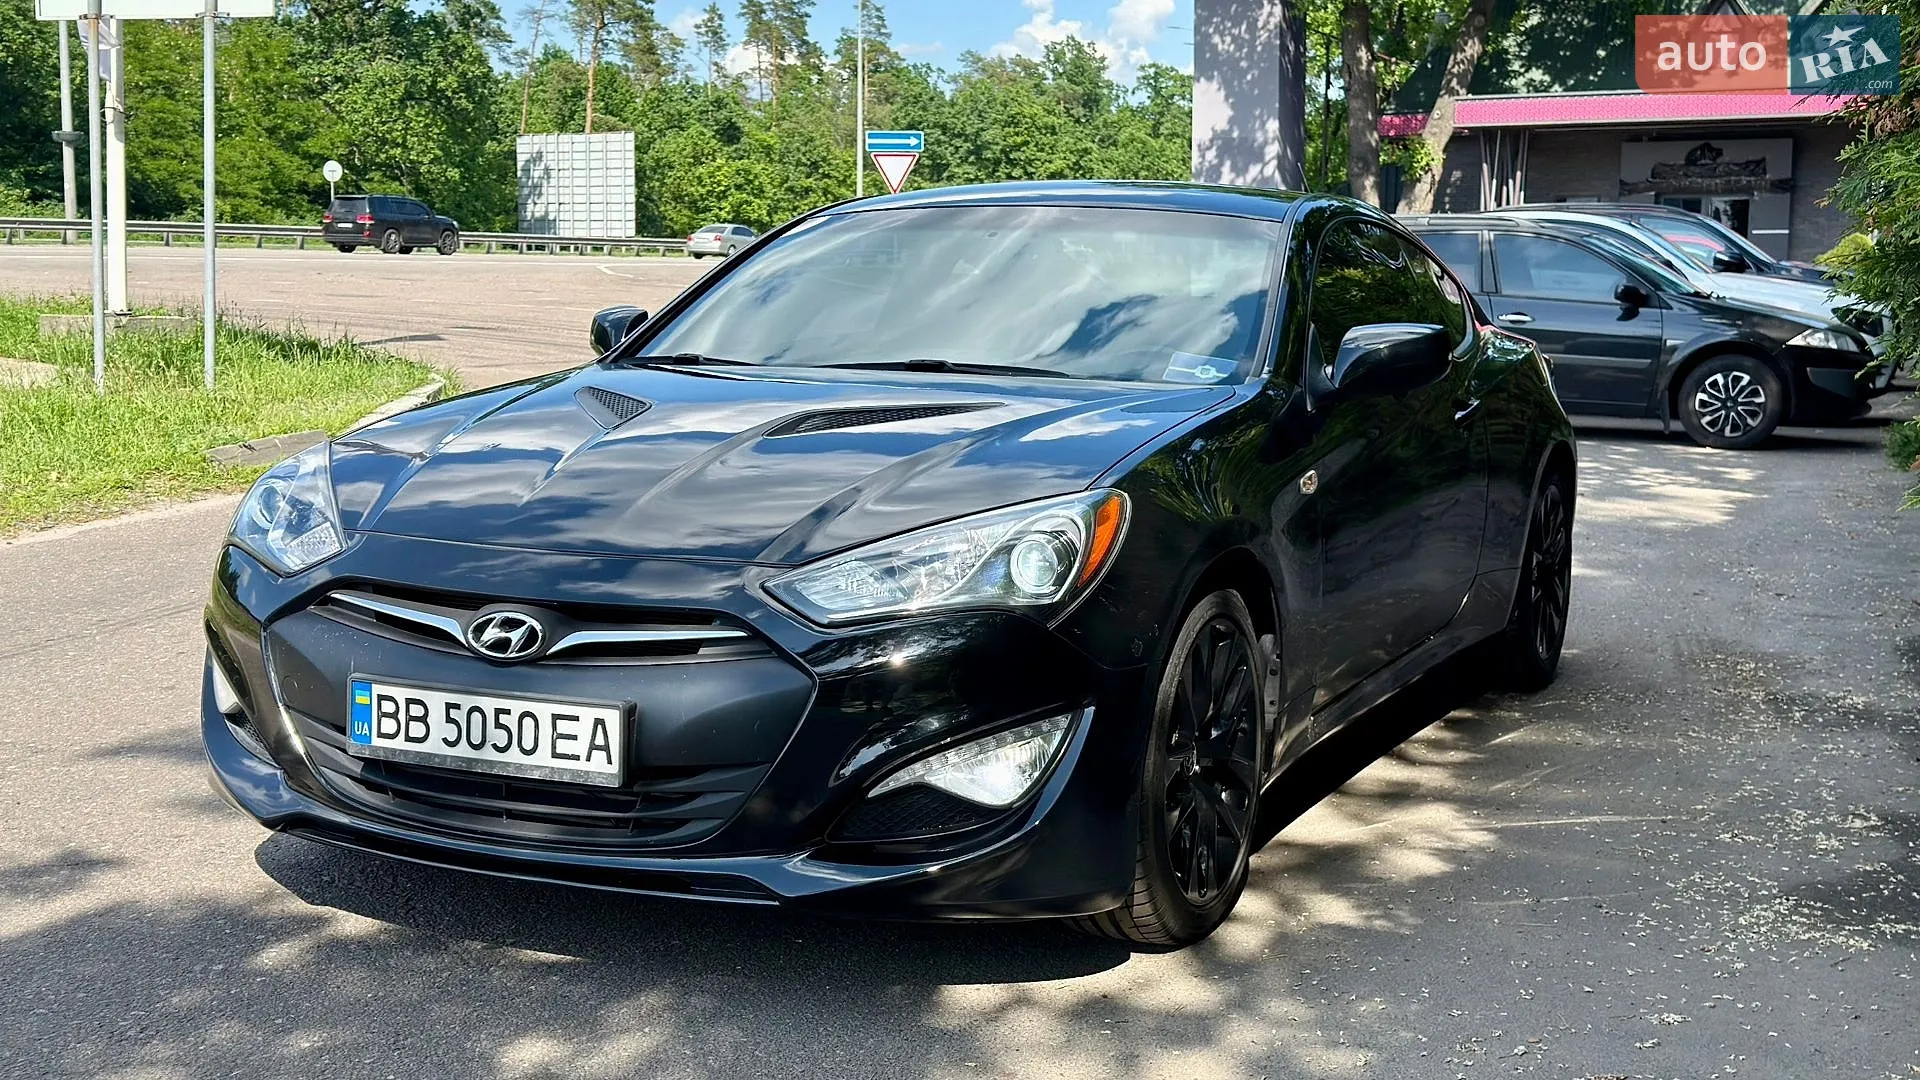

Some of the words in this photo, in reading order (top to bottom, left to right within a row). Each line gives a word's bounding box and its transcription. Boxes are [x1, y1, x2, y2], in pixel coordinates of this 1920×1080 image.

[354, 720, 370, 737] UA
[376, 693, 431, 744] BB
[441, 701, 540, 756] 5050
[550, 713, 613, 765] EA
